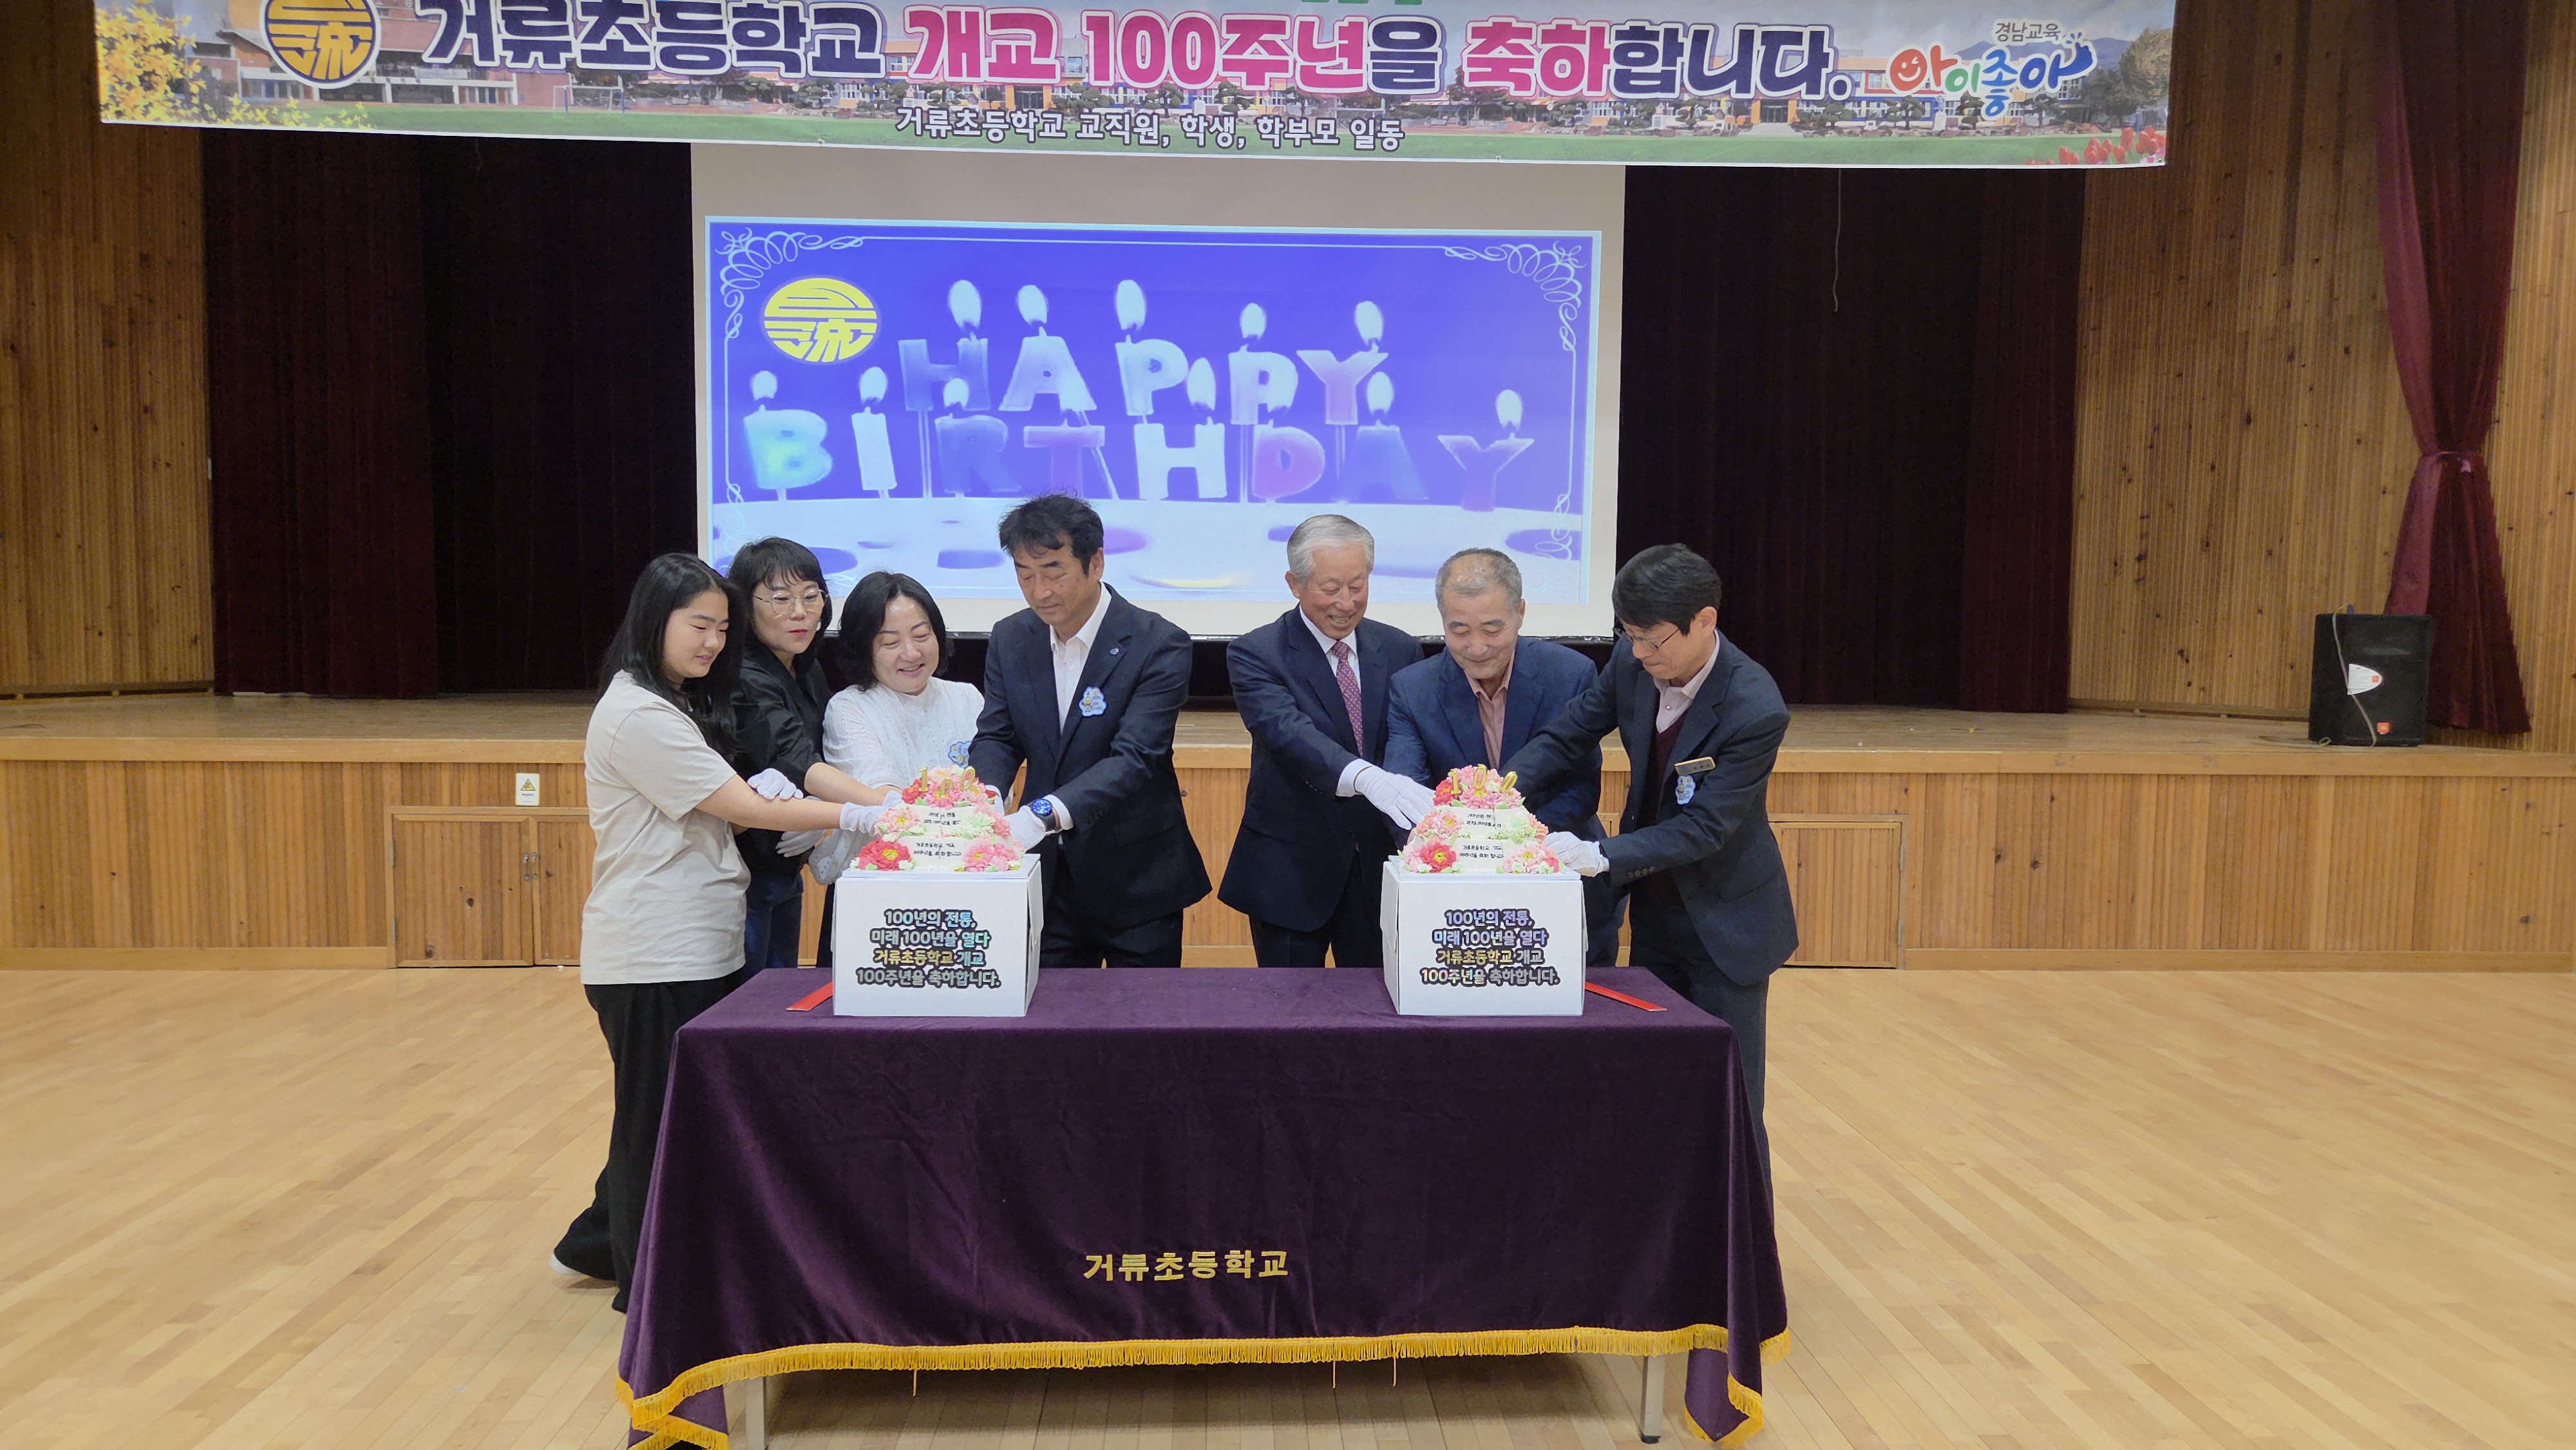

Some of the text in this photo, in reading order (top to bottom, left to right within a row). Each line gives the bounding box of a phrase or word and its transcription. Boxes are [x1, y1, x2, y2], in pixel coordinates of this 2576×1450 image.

[1996, 21, 2061, 42] 경남교육
[417, 0, 885, 77] 거류초등학교
[906, 6, 1060, 82] 개교
[1081, 10, 1445, 94] 100주년을
[1465, 17, 1852, 100] 축하합니다.
[1889, 33, 2094, 117] 아이좋아
[896, 108, 1405, 151] 거류초등학교 교직원, 학생, 학부모 일동
[898, 335, 1388, 426] HAPPY
[743, 407, 1535, 513] BIRTHDAY
[1448, 764, 1518, 795] 100
[885, 910, 976, 928] 100년의 전통,
[1446, 910, 1533, 927] 100년의 전통,
[871, 929, 990, 947] 미래 100년을 열다
[1434, 930, 1548, 946] 미래 100년을 열다
[874, 949, 985, 966] 거류초등학교 개교
[1437, 950, 1544, 965] 거류초등학교 개교
[857, 969, 1000, 986] 100주년을 축하합니다.
[1421, 969, 1558, 984] 100주년을 축하합니다.
[1083, 1250, 1289, 1281] 거류초등학교
